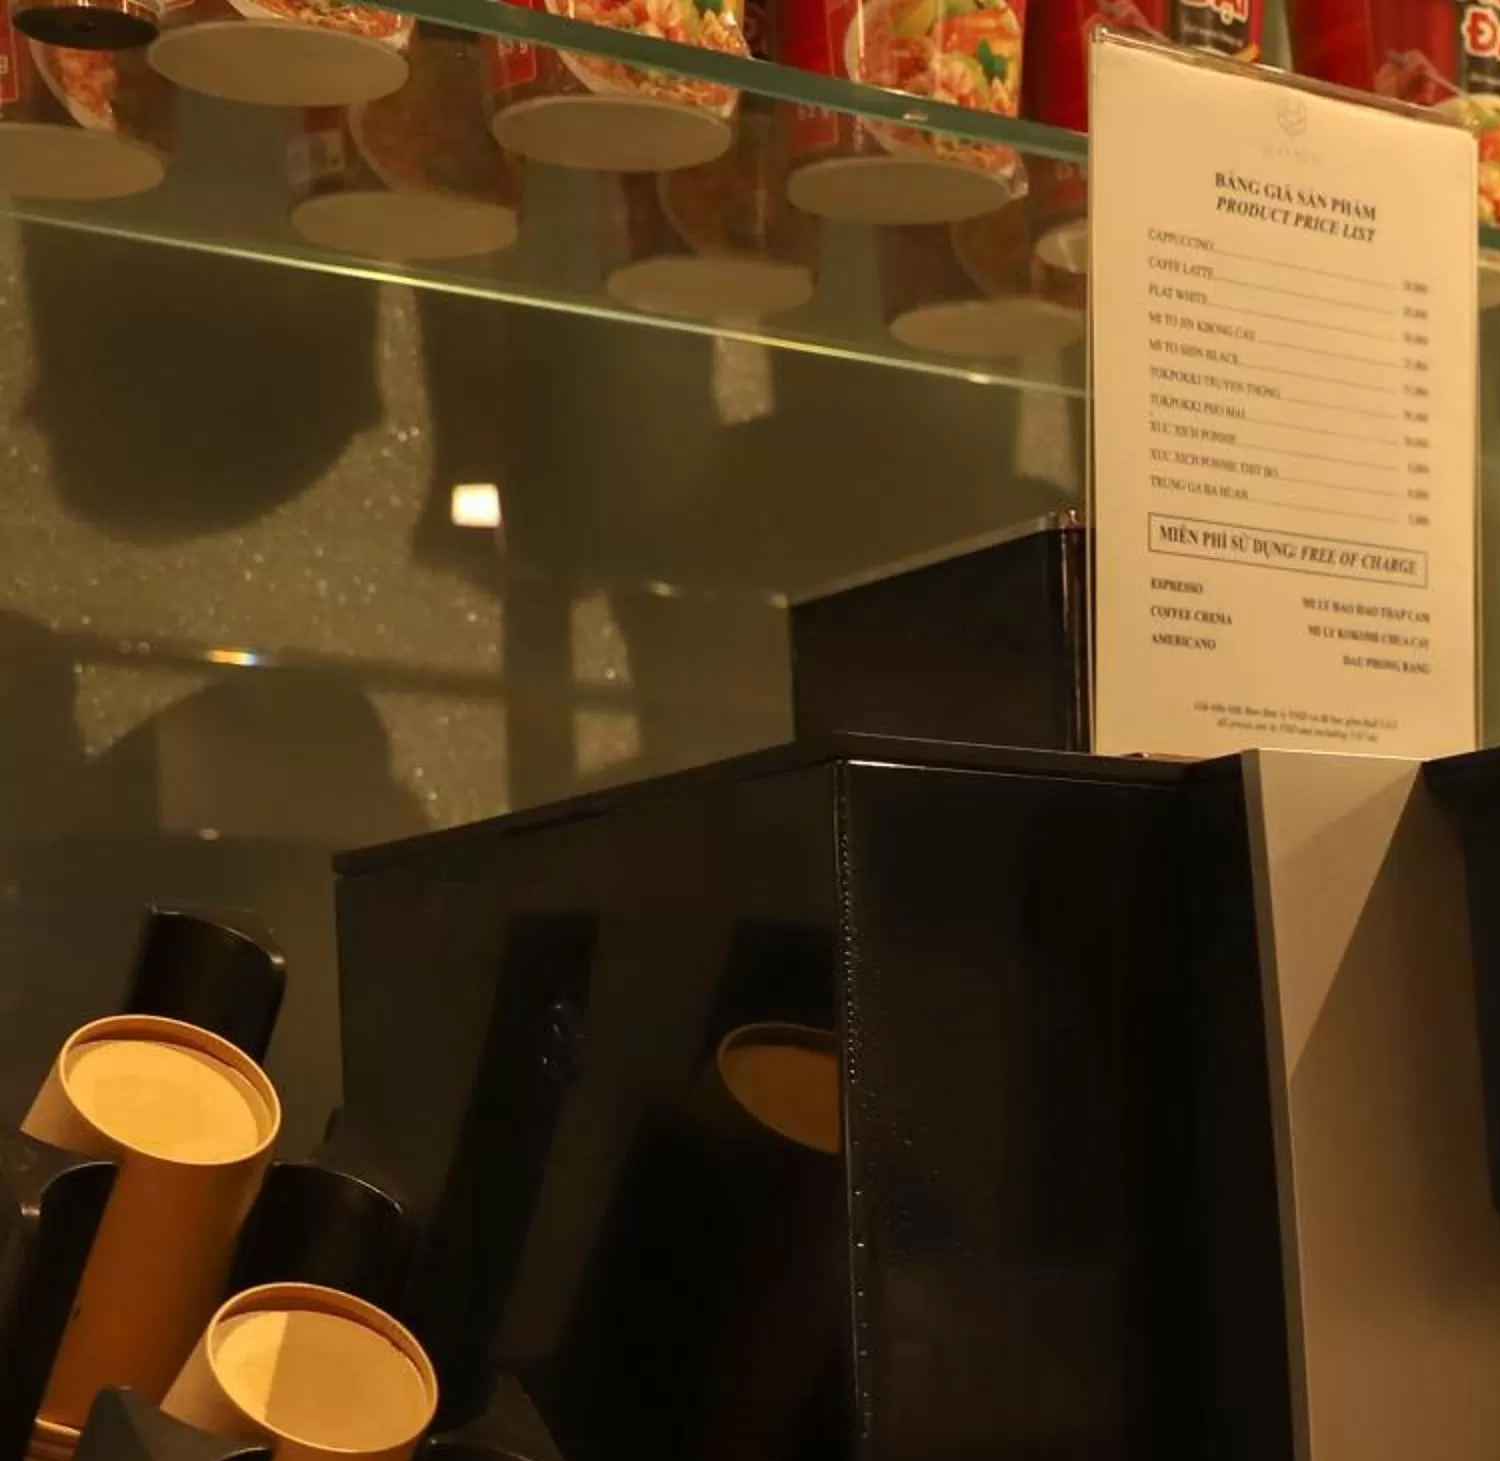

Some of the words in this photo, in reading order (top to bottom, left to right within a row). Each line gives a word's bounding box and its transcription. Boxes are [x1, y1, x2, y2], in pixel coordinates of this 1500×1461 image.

[1215, 195, 1291, 226] PRODUCT
[1293, 211, 1339, 236] PRICE
[1342, 223, 1377, 244] LIST
[1300, 544, 1337, 565] FREE
[1338, 551, 1359, 567] OF
[1360, 553, 1418, 576] CHARGE
[1150, 576, 1204, 596] ESPRESSO
[1150, 604, 1191, 623] COFFEE
[1193, 609, 1233, 626] CREMA
[1151, 632, 1217, 651] AMERICANO
